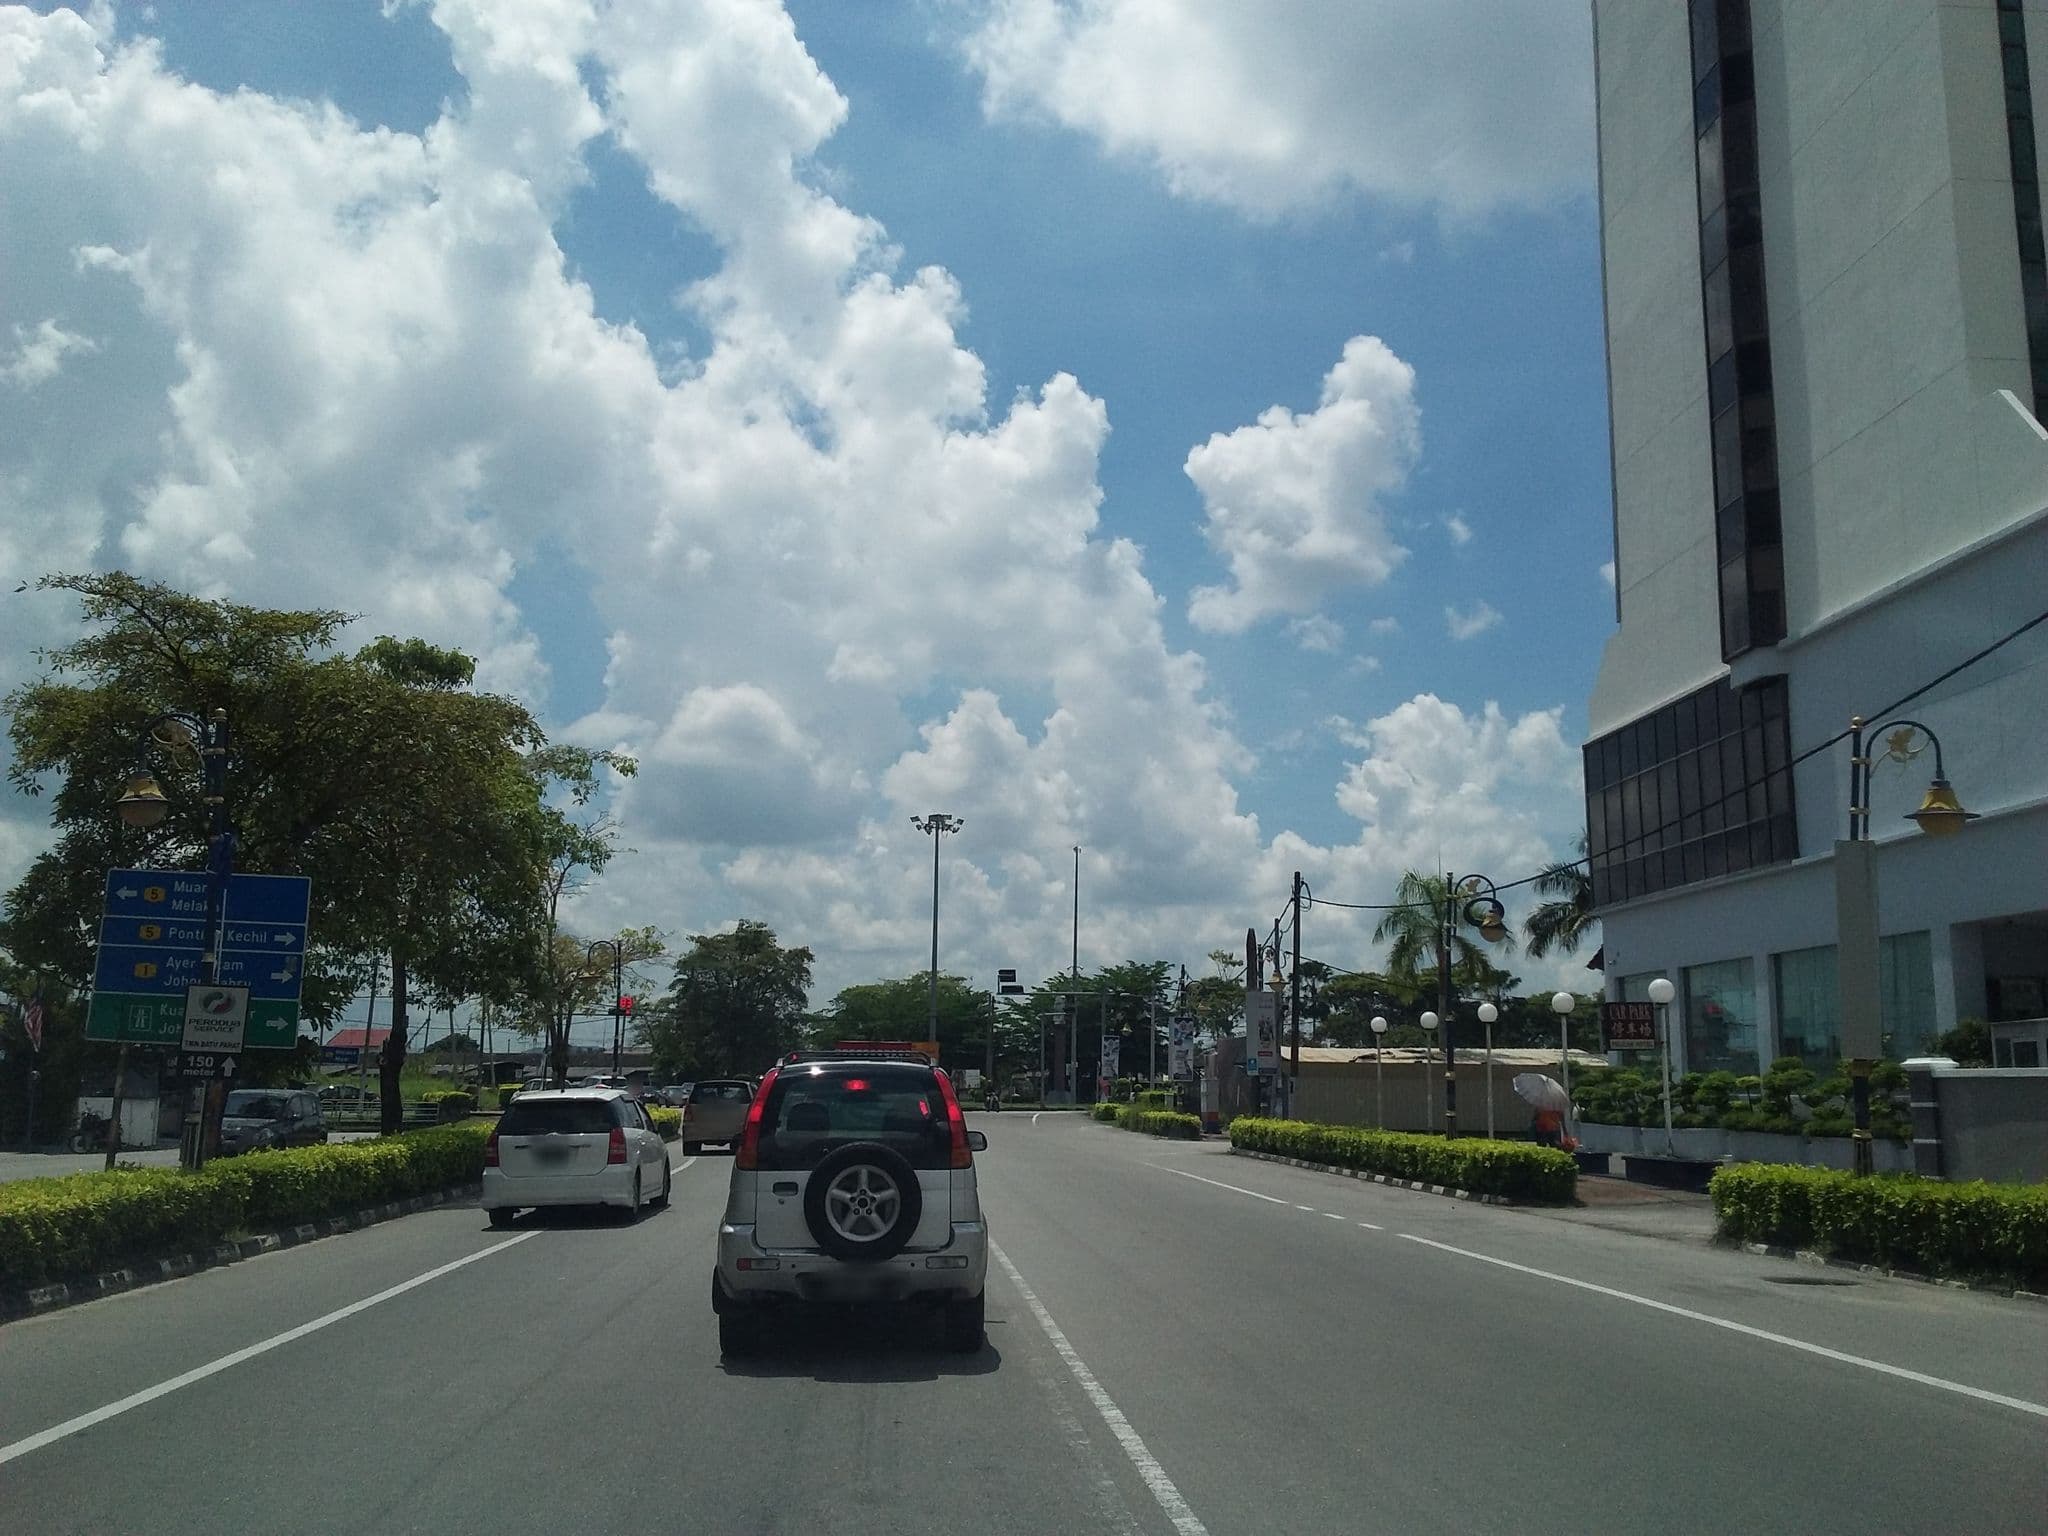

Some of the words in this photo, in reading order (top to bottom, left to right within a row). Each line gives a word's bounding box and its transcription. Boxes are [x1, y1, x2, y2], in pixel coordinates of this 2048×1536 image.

[174, 880, 208, 893] Muar
[150, 888, 158, 899] 5
[171, 899, 219, 912] Melak
[146, 927, 154, 937] 5
[169, 927, 209, 941] Ponti
[226, 929, 267, 943] Kechil
[166, 956, 196, 970] Ayer
[160, 1003, 185, 1016] Kua
[1609, 1004, 1627, 1019] CAR
[1629, 1004, 1651, 1019] PARK
[188, 1018, 241, 1027] PERODUA
[187, 1055, 214, 1067] 150
[183, 1068, 216, 1076] meter
